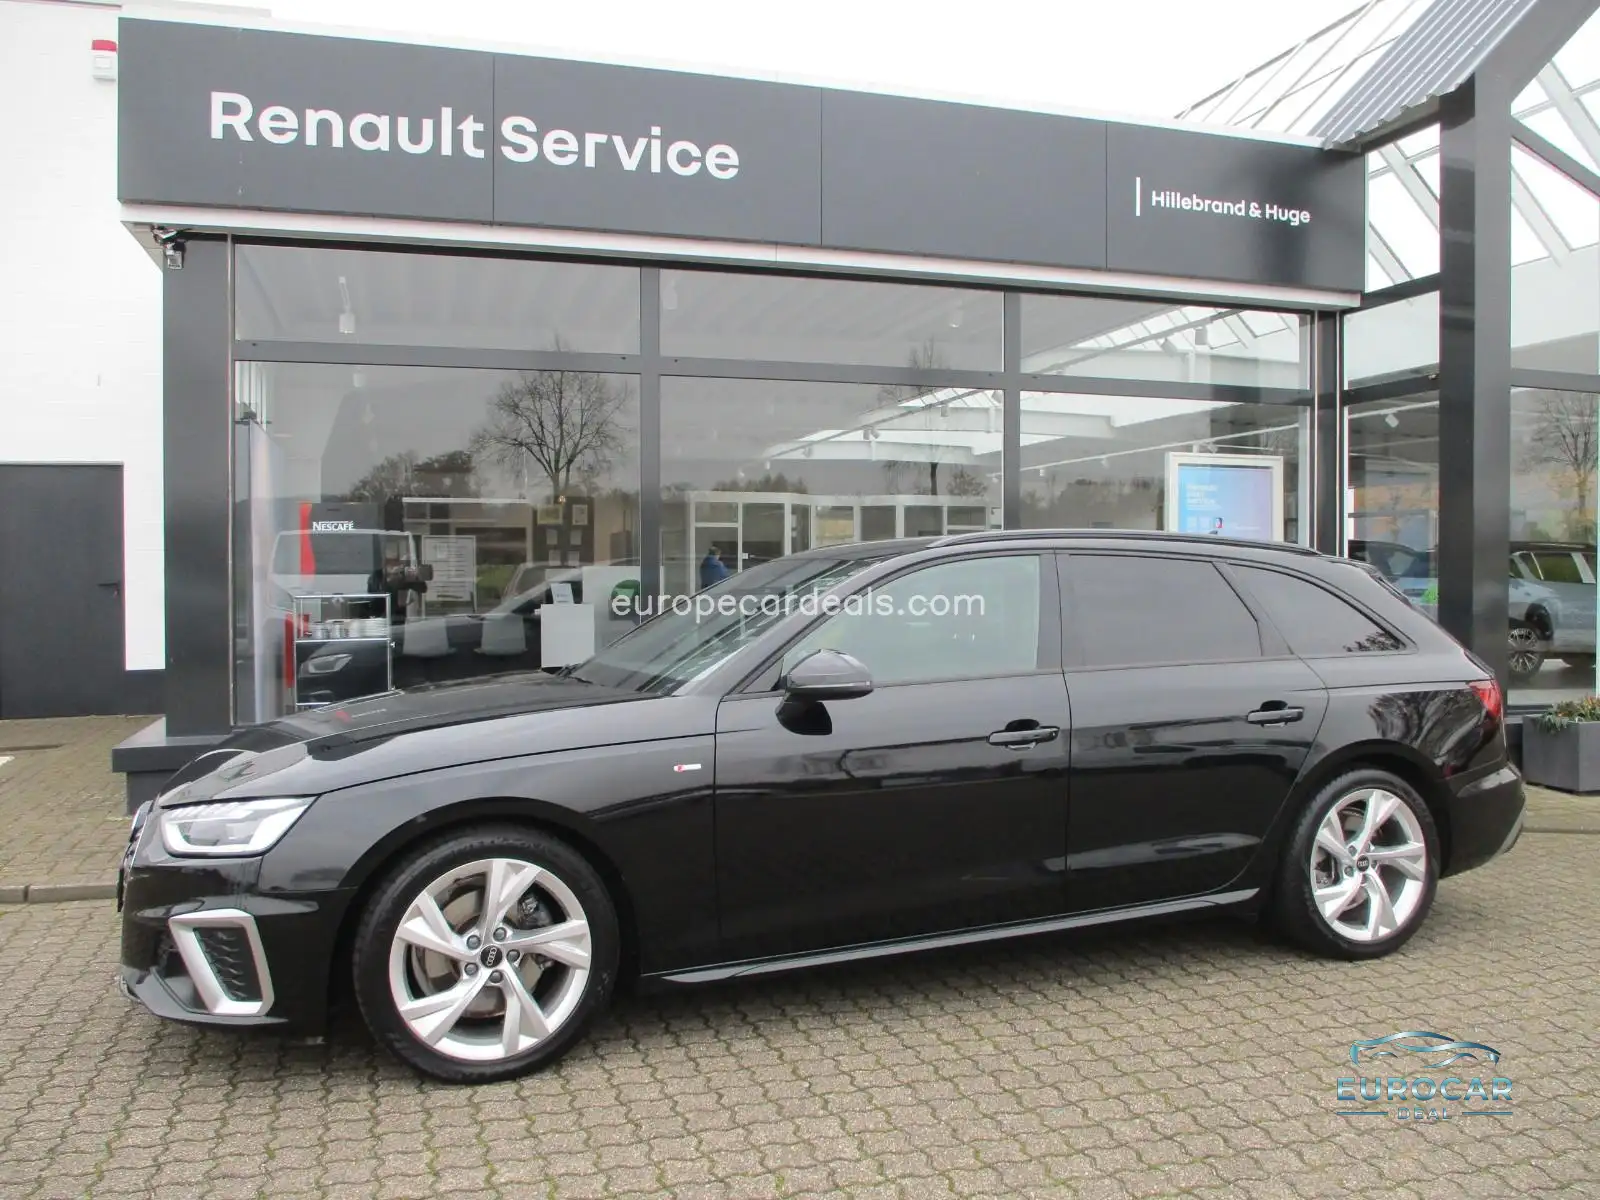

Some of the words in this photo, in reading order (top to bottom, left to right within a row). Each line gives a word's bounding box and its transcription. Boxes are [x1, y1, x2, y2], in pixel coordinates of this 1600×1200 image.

[209, 91, 485, 159] Renault
[500, 116, 740, 180] Service
[1151, 190, 1246, 217] Hillebrand
[1248, 202, 1262, 219] &
[1265, 203, 1311, 226] Huge
